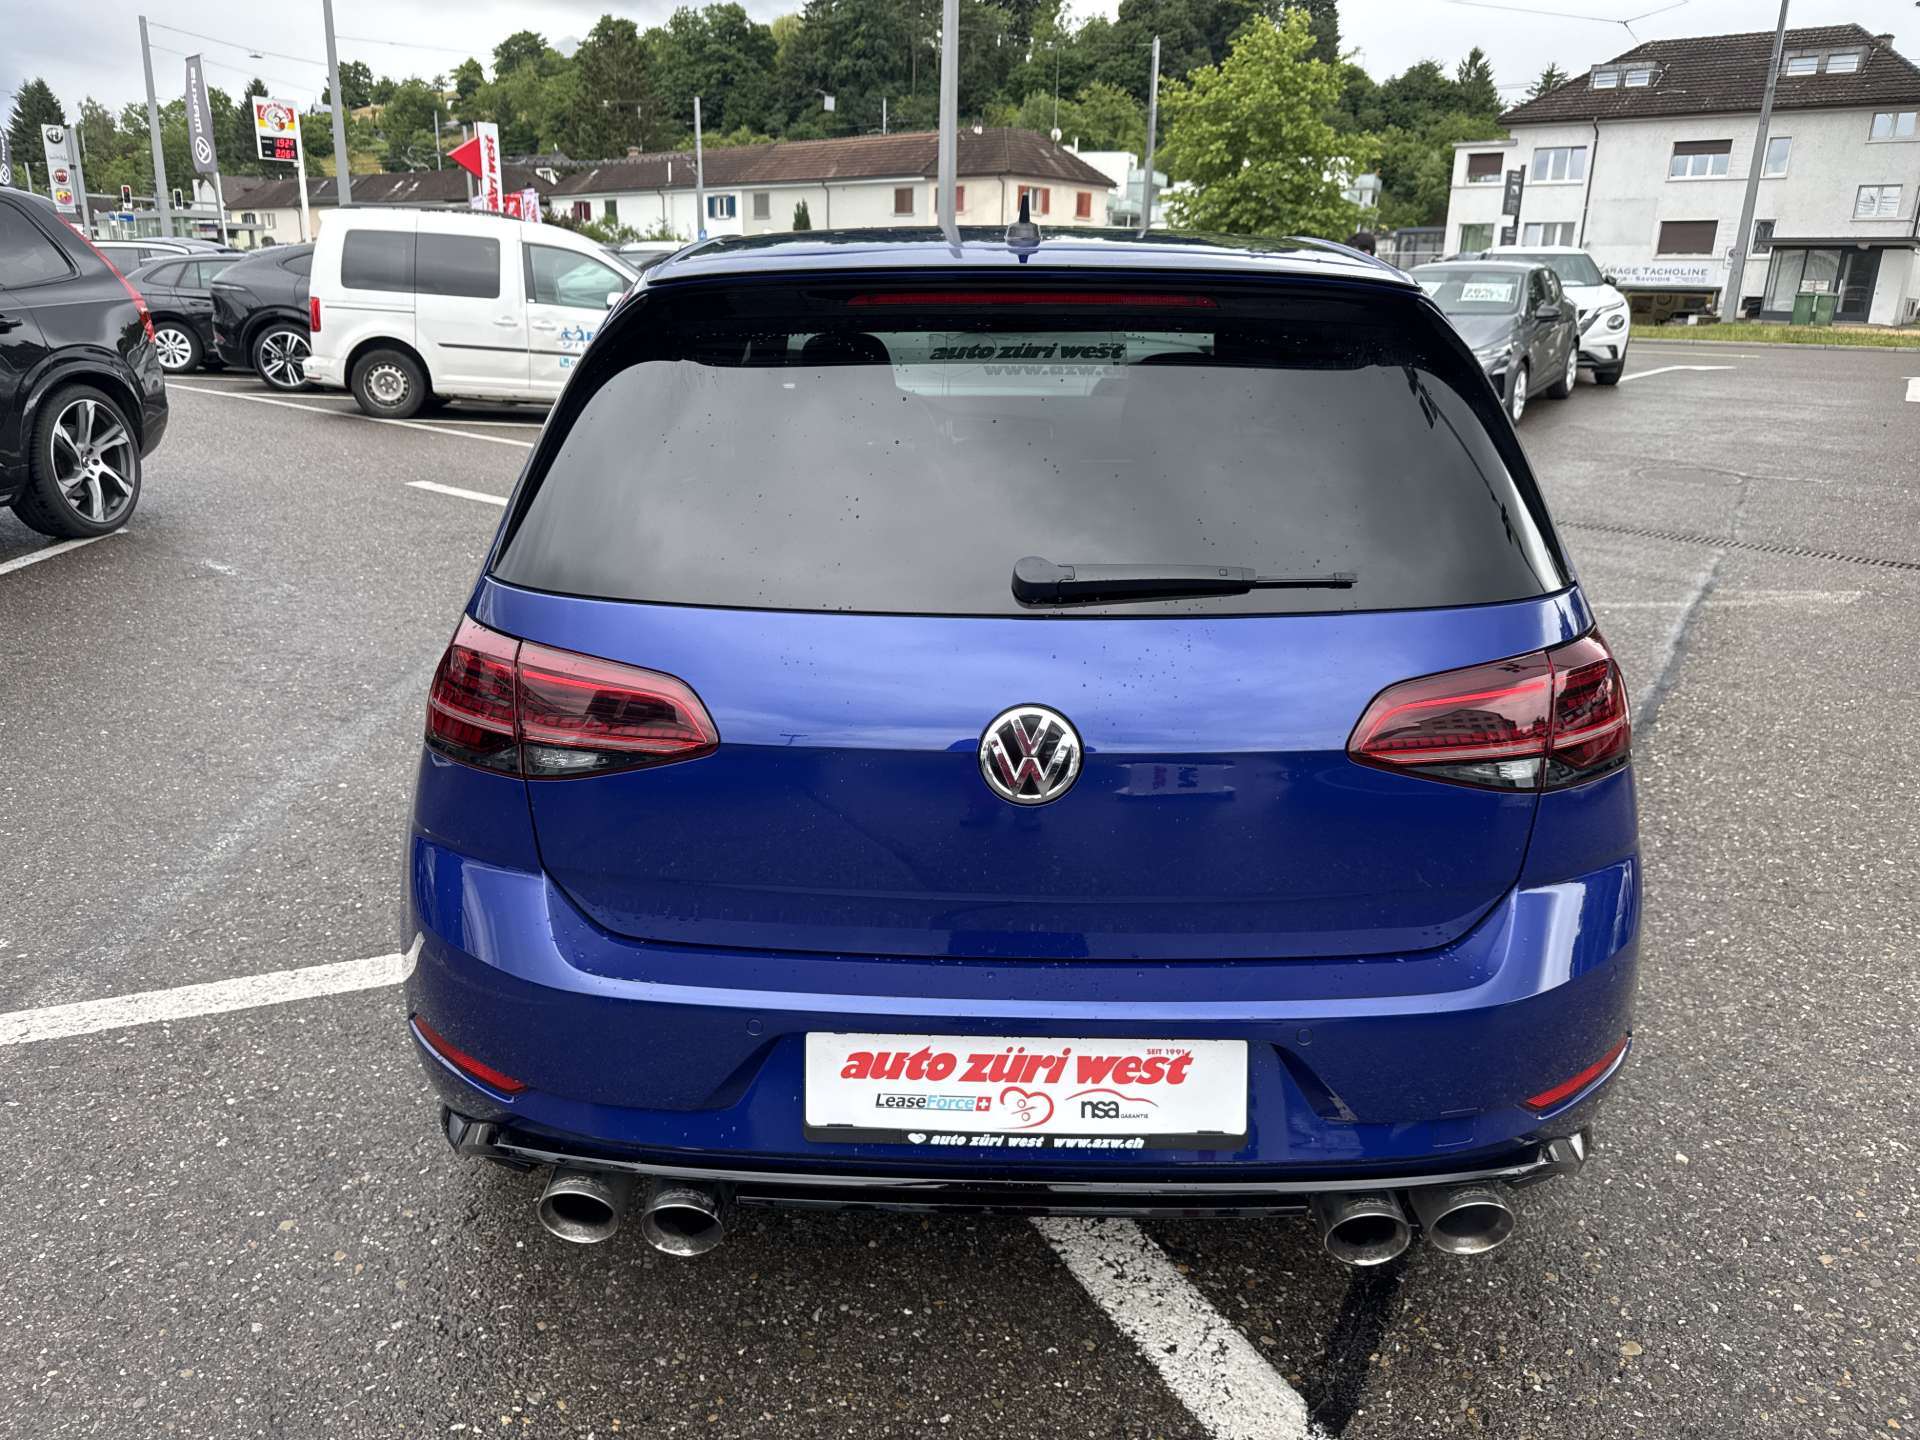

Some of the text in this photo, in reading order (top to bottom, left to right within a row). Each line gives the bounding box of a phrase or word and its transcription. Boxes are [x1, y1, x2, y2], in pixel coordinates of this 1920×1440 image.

[929, 342, 1126, 360] auto züri west
[984, 365, 1127, 376] www.azw.c
[840, 1045, 1194, 1085] auto züri west
[875, 1093, 975, 1110] LeaseForce
[1081, 1100, 1120, 1119] nsa
[930, 1134, 1144, 1149] auto züri west www.azw.ch
